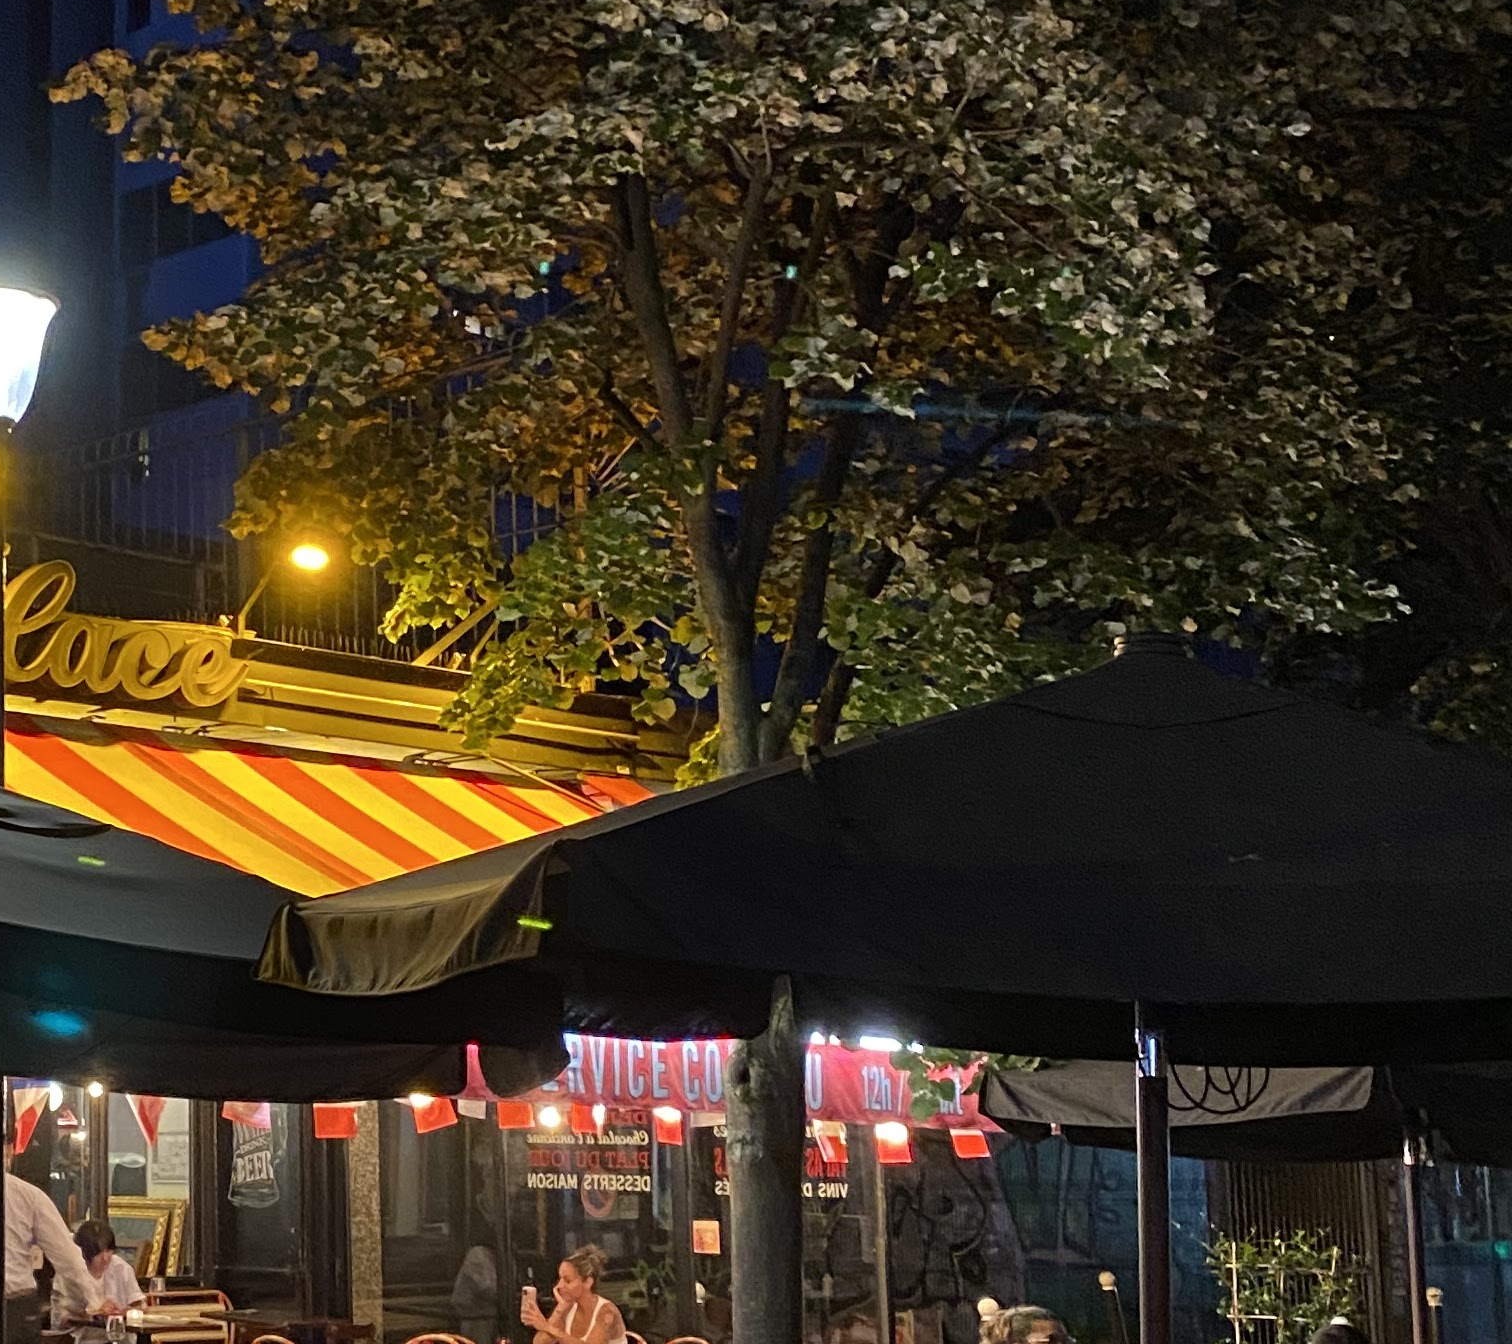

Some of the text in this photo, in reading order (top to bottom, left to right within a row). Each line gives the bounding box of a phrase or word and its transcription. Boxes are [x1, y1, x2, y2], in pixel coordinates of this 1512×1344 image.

[543, 1034, 672, 1100] RVICE
[861, 1065, 893, 1111] 12h
[235, 1150, 274, 1184] BEER
